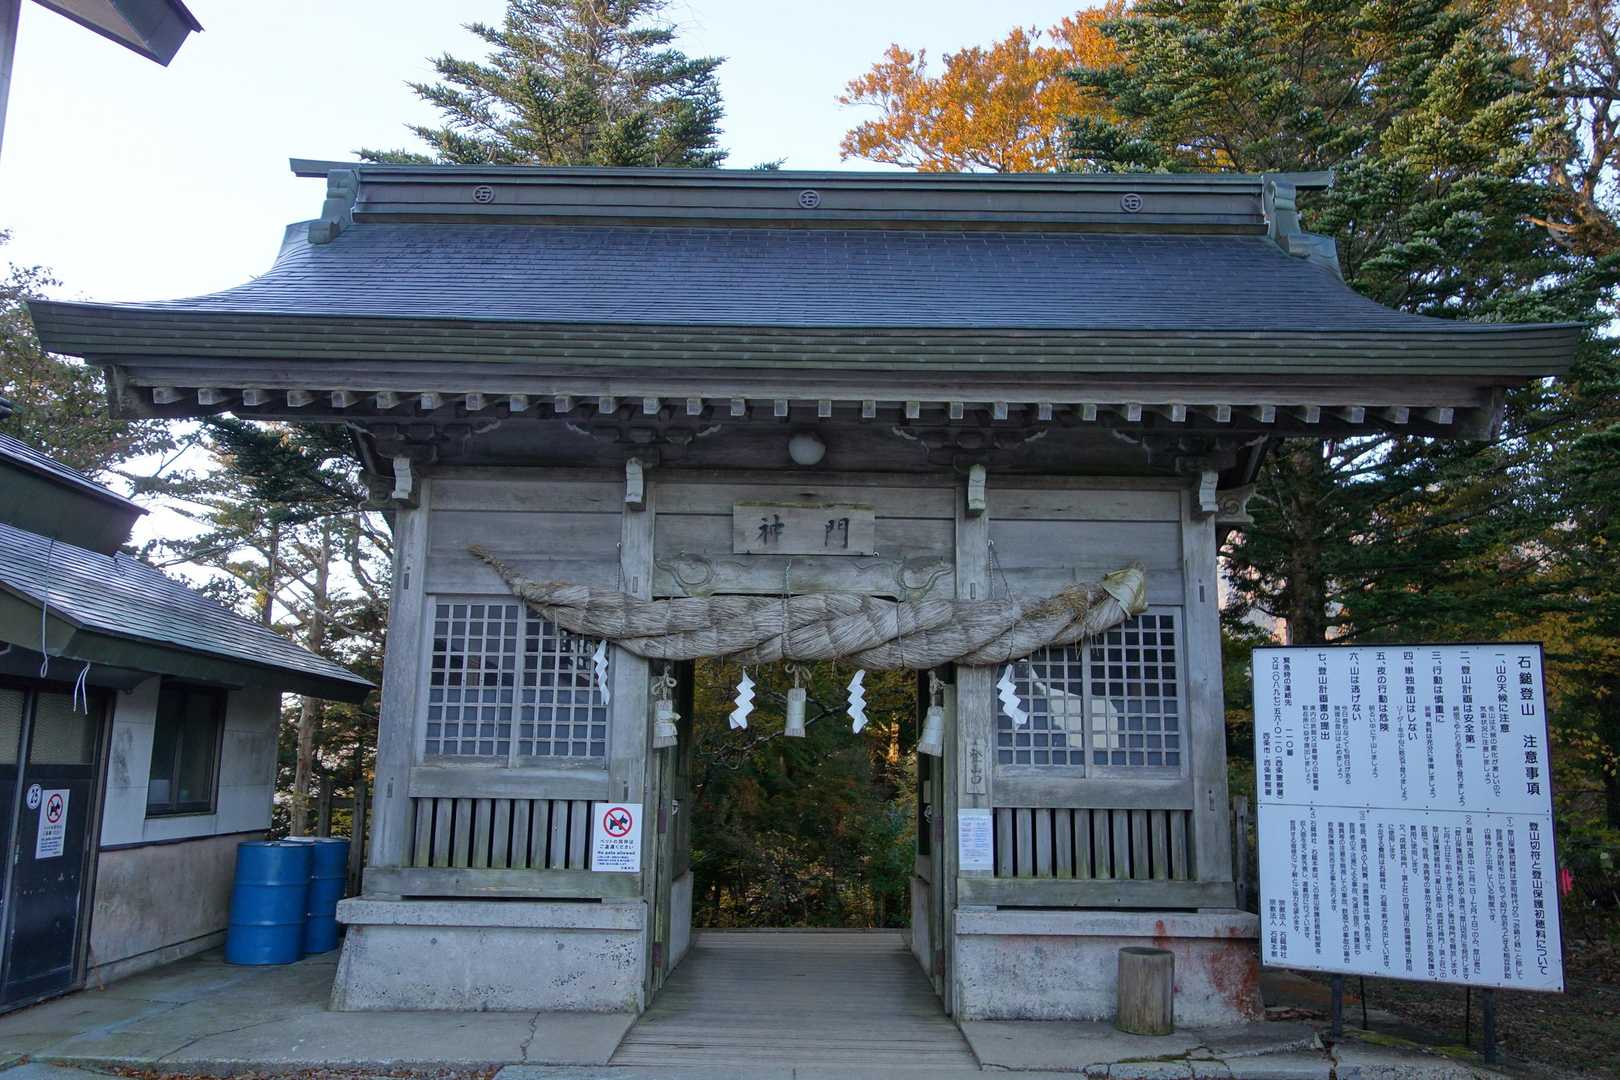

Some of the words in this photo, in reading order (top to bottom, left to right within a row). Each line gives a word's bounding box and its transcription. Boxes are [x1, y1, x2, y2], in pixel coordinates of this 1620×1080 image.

[1282, 656, 1292, 706] 緊急時の連絡先
[1317, 653, 1329, 740] 七、登山計画書の提出
[1349, 652, 1361, 720] 六、山は逃げない
[1376, 651, 1389, 732] 五、夜の行動は危険
[1403, 651, 1417, 740] 四、単独登山はしない
[1431, 651, 1444, 723] 三、行動は慎重に
[1460, 651, 1475, 748] 二、登山計画は安全第一
[1495, 653, 1510, 733] 一、山の天候に注意
[1517, 656, 1534, 715] 石鎚登山
[1522, 734, 1540, 795] 注意事項
[1528, 821, 1547, 975] 登山切符と登山保護初穂料について
